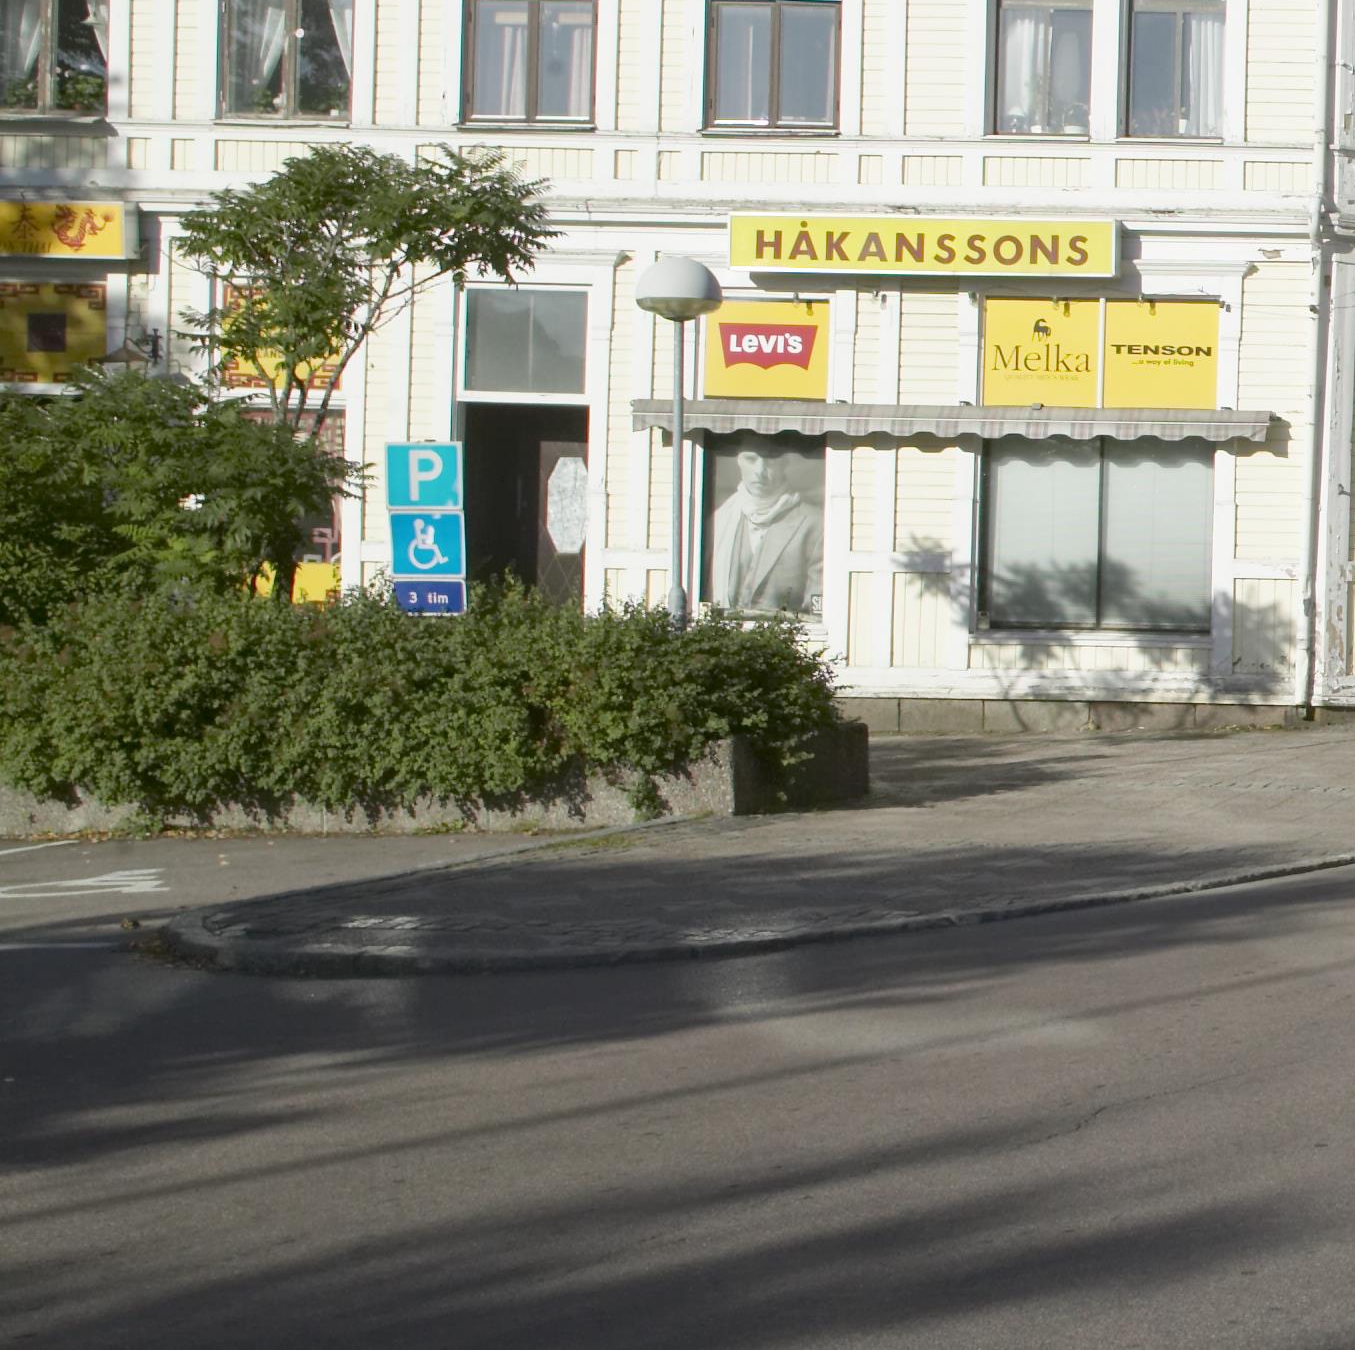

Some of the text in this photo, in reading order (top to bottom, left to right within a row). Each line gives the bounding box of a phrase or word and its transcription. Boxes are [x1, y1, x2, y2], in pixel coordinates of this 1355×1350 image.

[755, 220, 1089, 266] HÅKANSSONS
[991, 343, 1091, 372] Melka
[1110, 344, 1212, 357] TENSON
[409, 450, 443, 501] P
[409, 591, 449, 604] 3 tim
